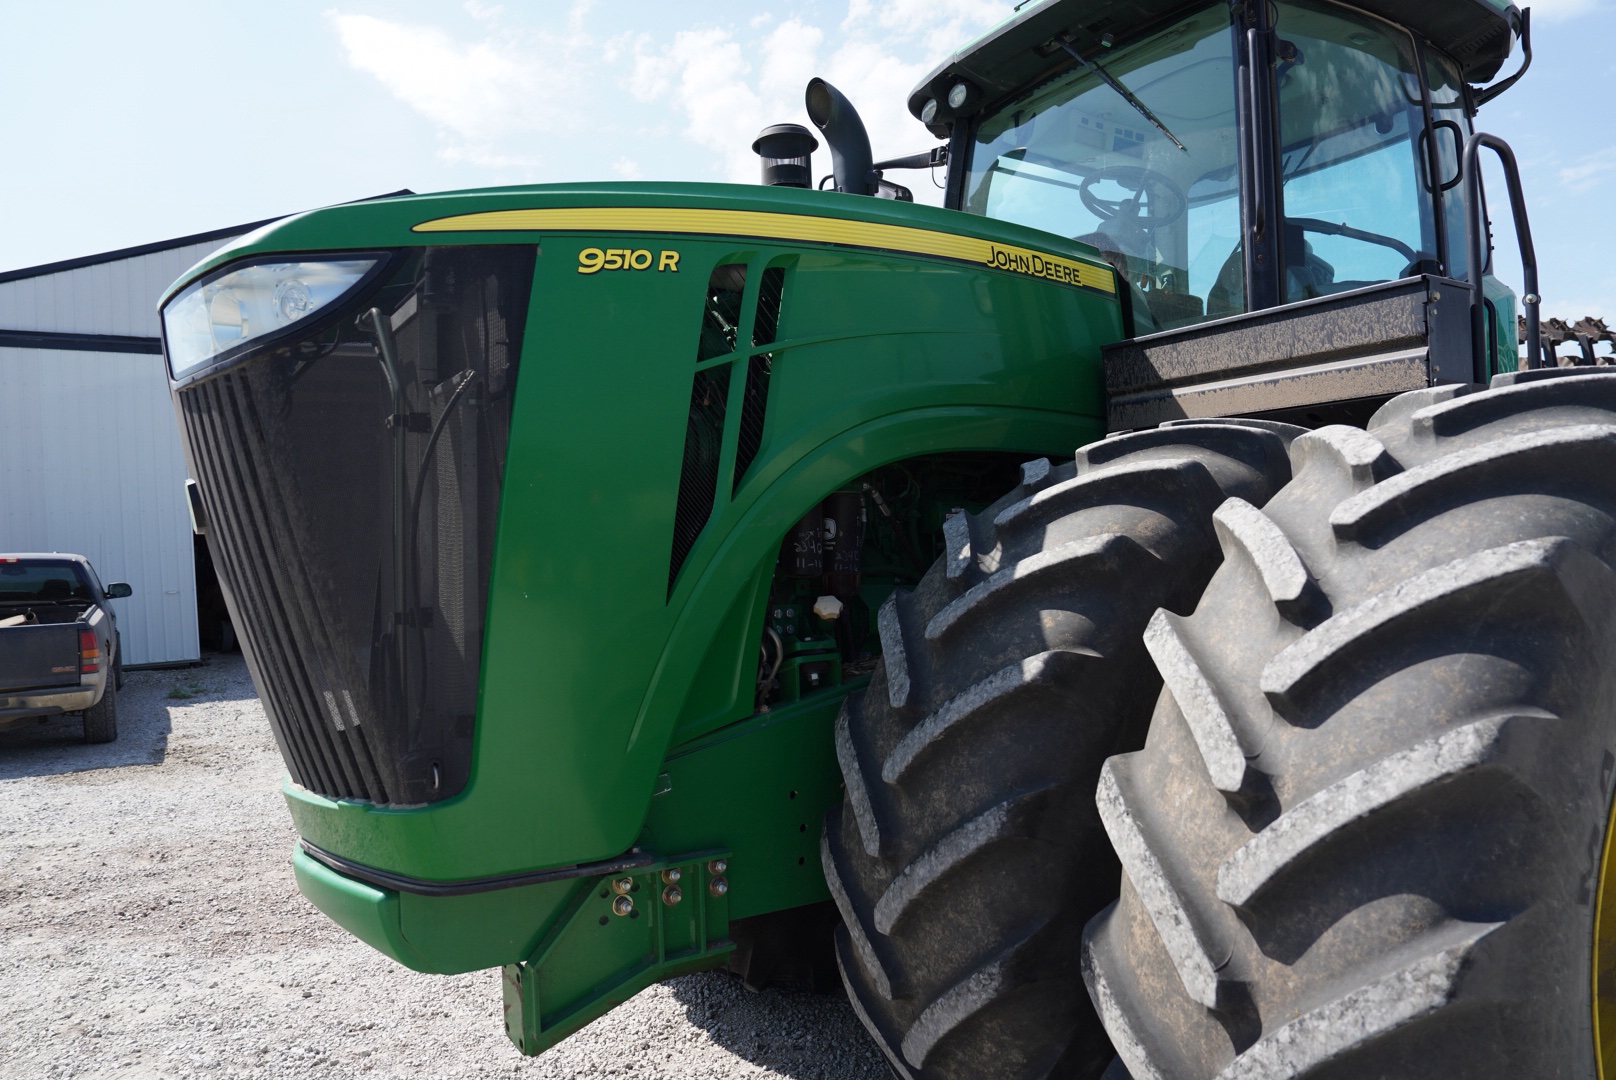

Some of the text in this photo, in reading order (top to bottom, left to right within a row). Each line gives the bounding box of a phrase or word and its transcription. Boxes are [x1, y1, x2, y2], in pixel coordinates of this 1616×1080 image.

[577, 247, 680, 275] 9510 R
[986, 245, 1082, 284] JOHN DEERE
